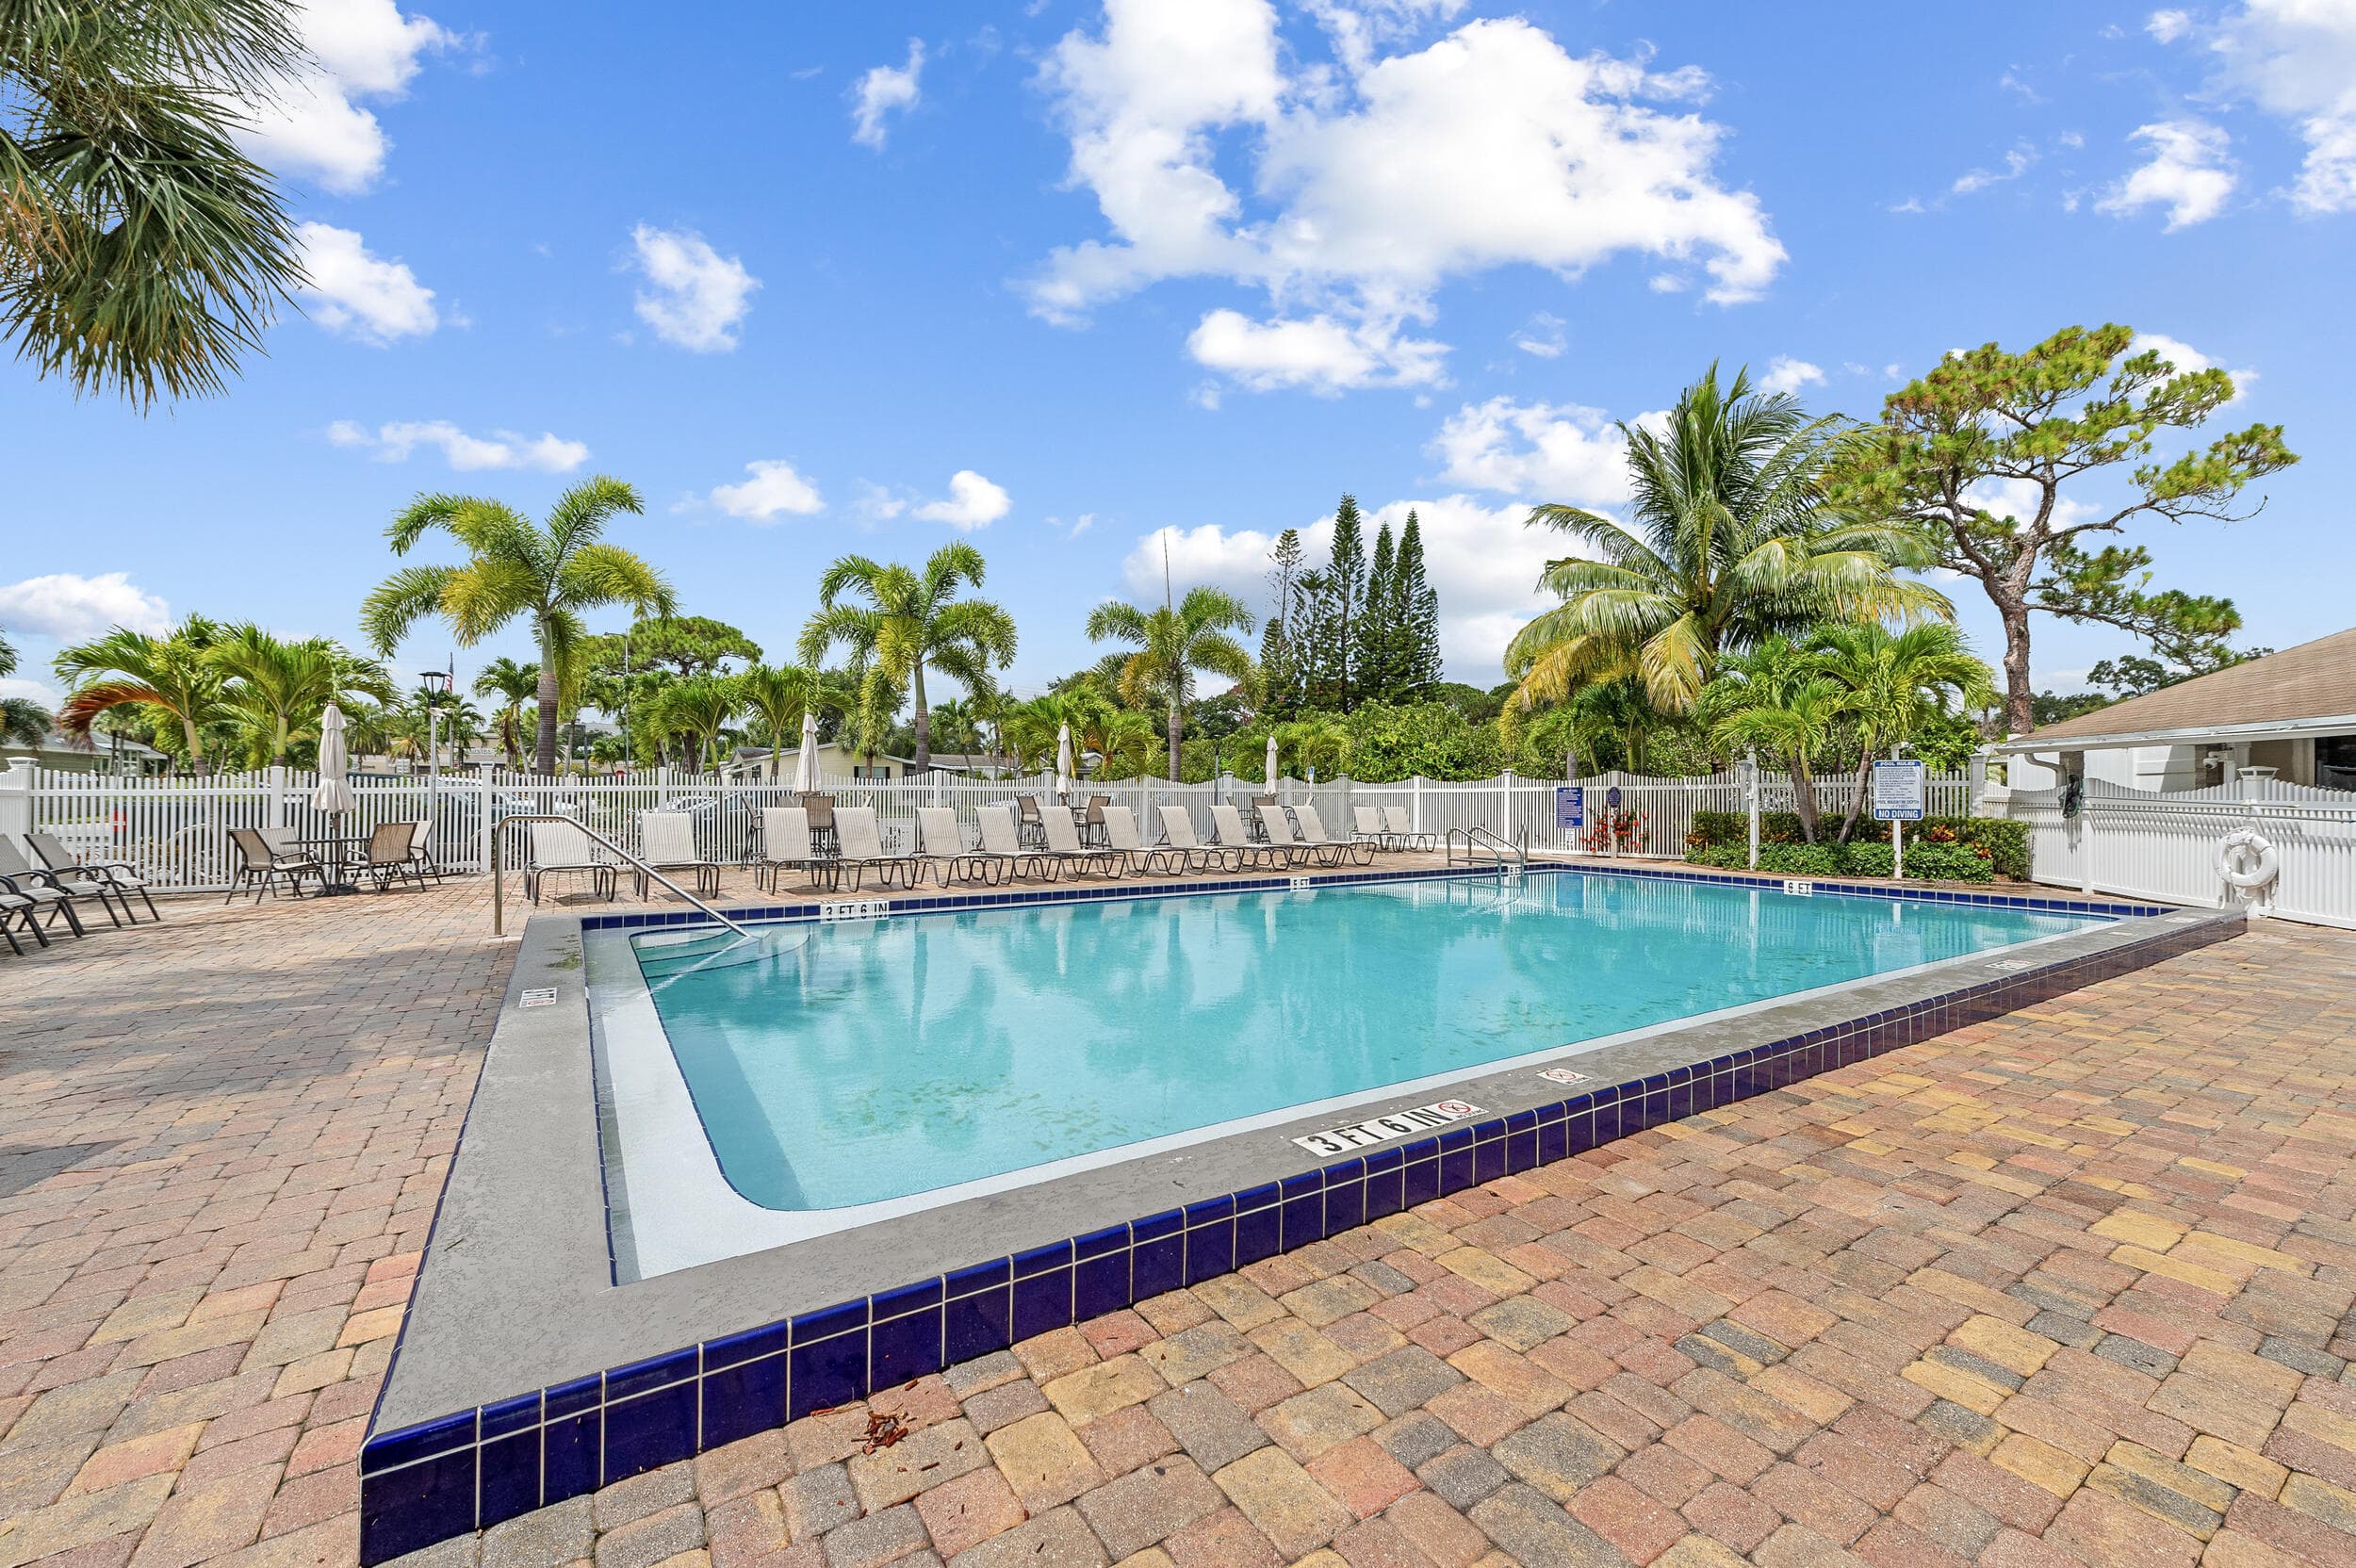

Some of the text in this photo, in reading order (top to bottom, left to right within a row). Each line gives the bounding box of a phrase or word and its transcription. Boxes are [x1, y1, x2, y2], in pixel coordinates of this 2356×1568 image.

[1308, 1108, 1453, 1152] 3 FT 6 IN
